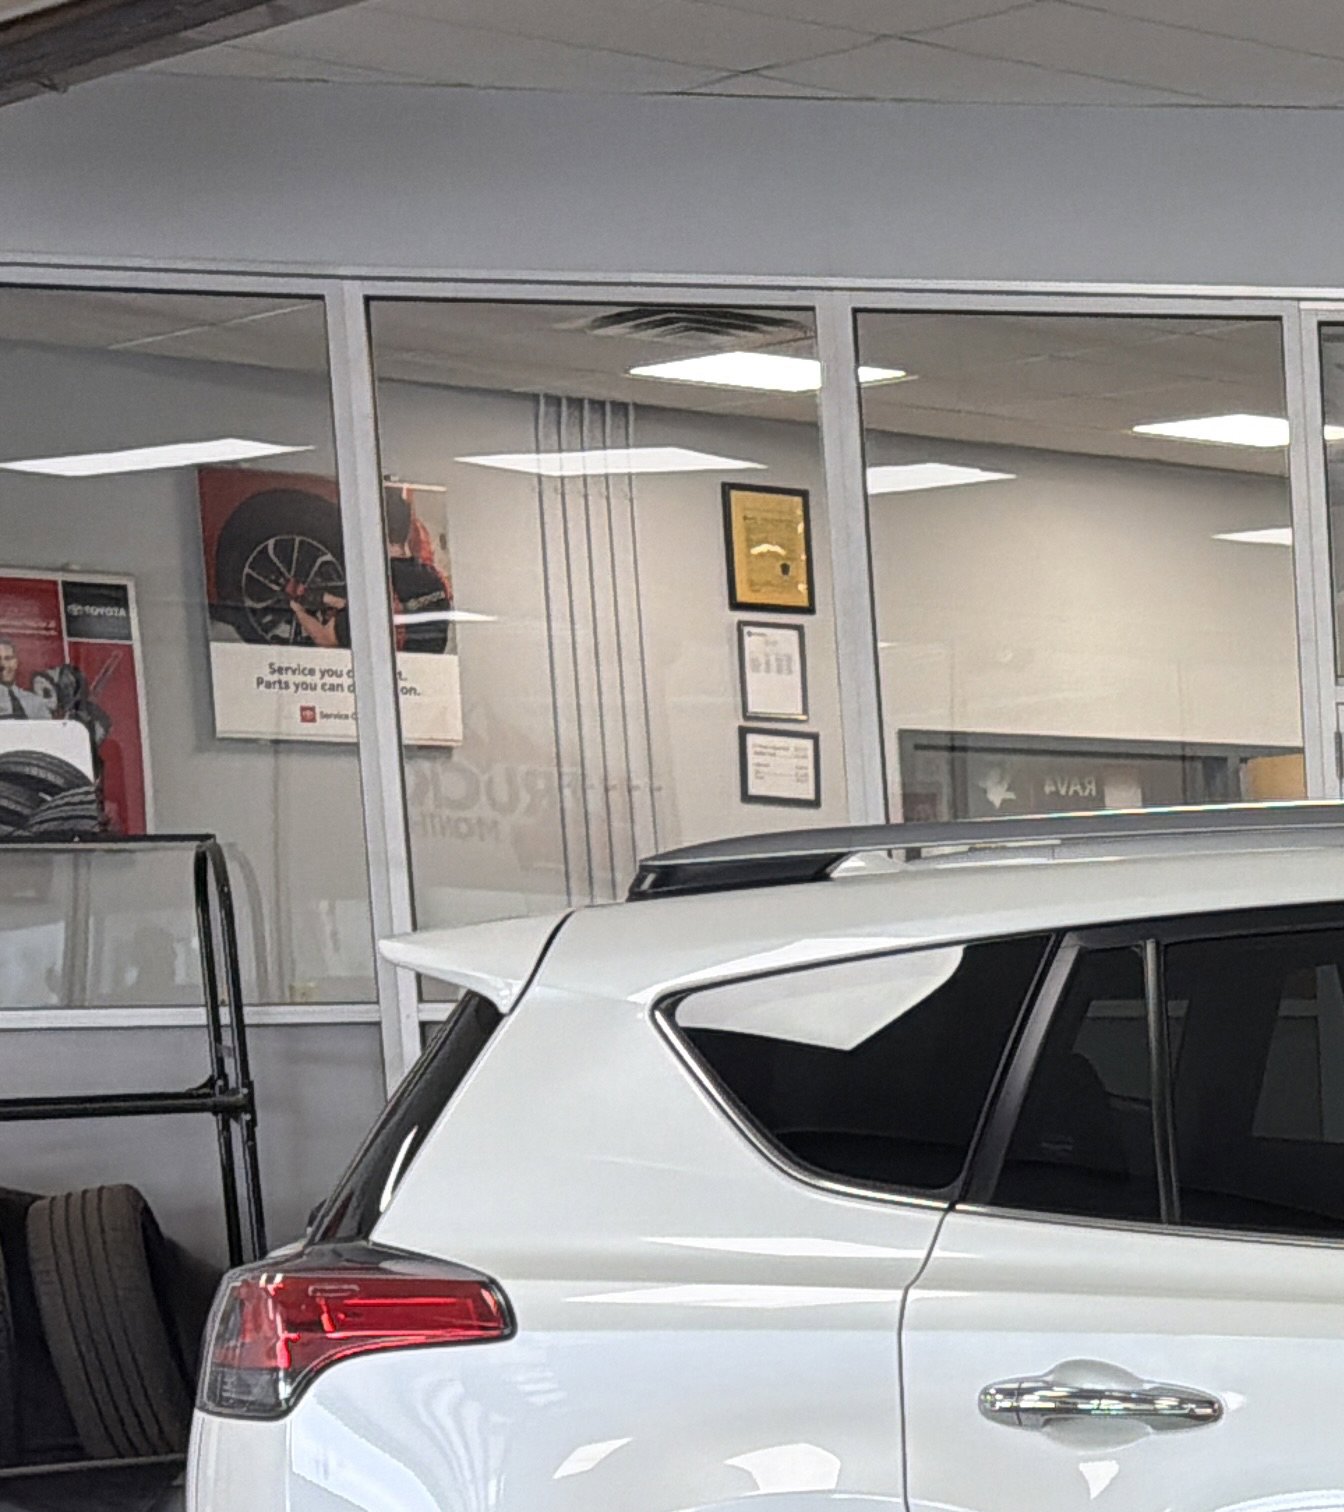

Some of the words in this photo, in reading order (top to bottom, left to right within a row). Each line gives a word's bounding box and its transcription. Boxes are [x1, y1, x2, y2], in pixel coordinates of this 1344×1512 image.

[268, 662, 316, 676] Service
[319, 669, 343, 679] you
[256, 676, 290, 690] Parts
[293, 682, 317, 693] you
[320, 683, 344, 693] can
